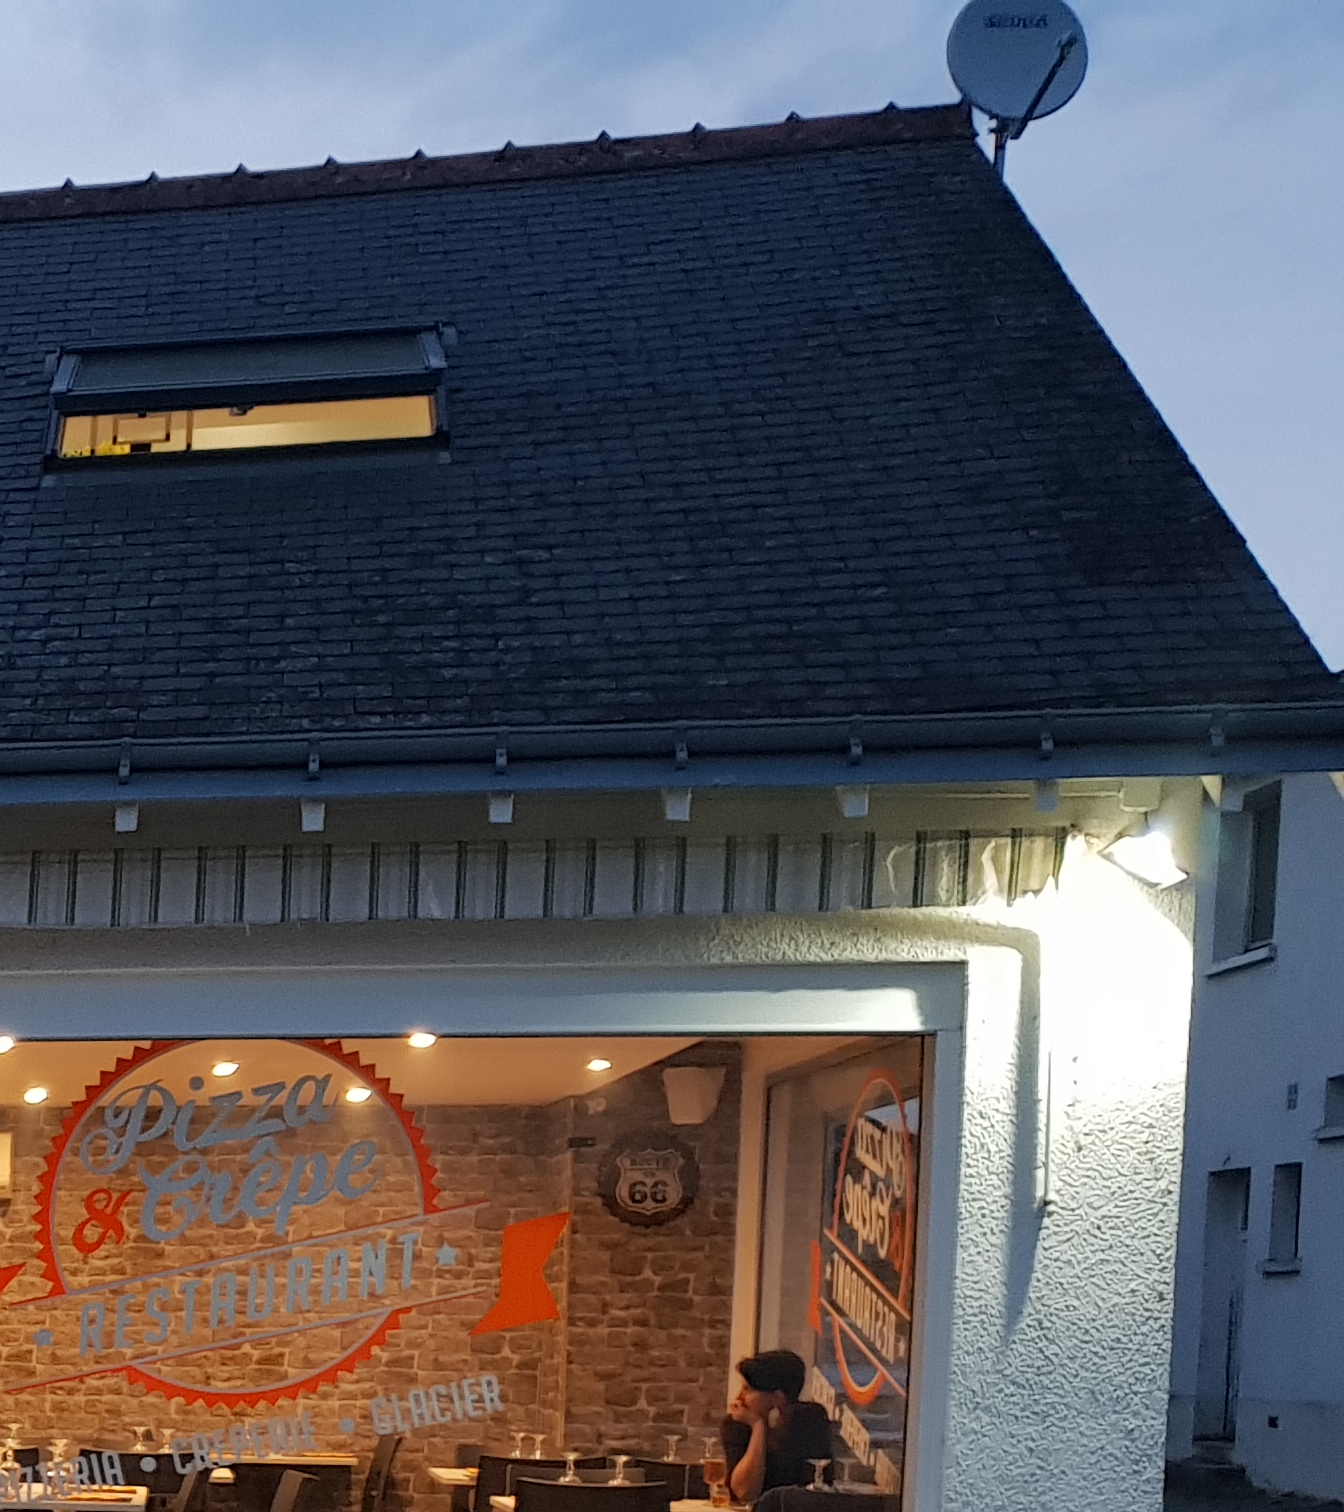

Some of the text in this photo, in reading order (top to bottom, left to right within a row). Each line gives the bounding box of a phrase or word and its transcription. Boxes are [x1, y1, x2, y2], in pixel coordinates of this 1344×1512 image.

[79, 1074, 338, 1175] Pizza
[72, 1136, 385, 1254] & Crêpe
[628, 1180, 670, 1204] 66
[79, 1232, 420, 1358] RESTAURANT
[370, 1374, 505, 1436] GLACIER
